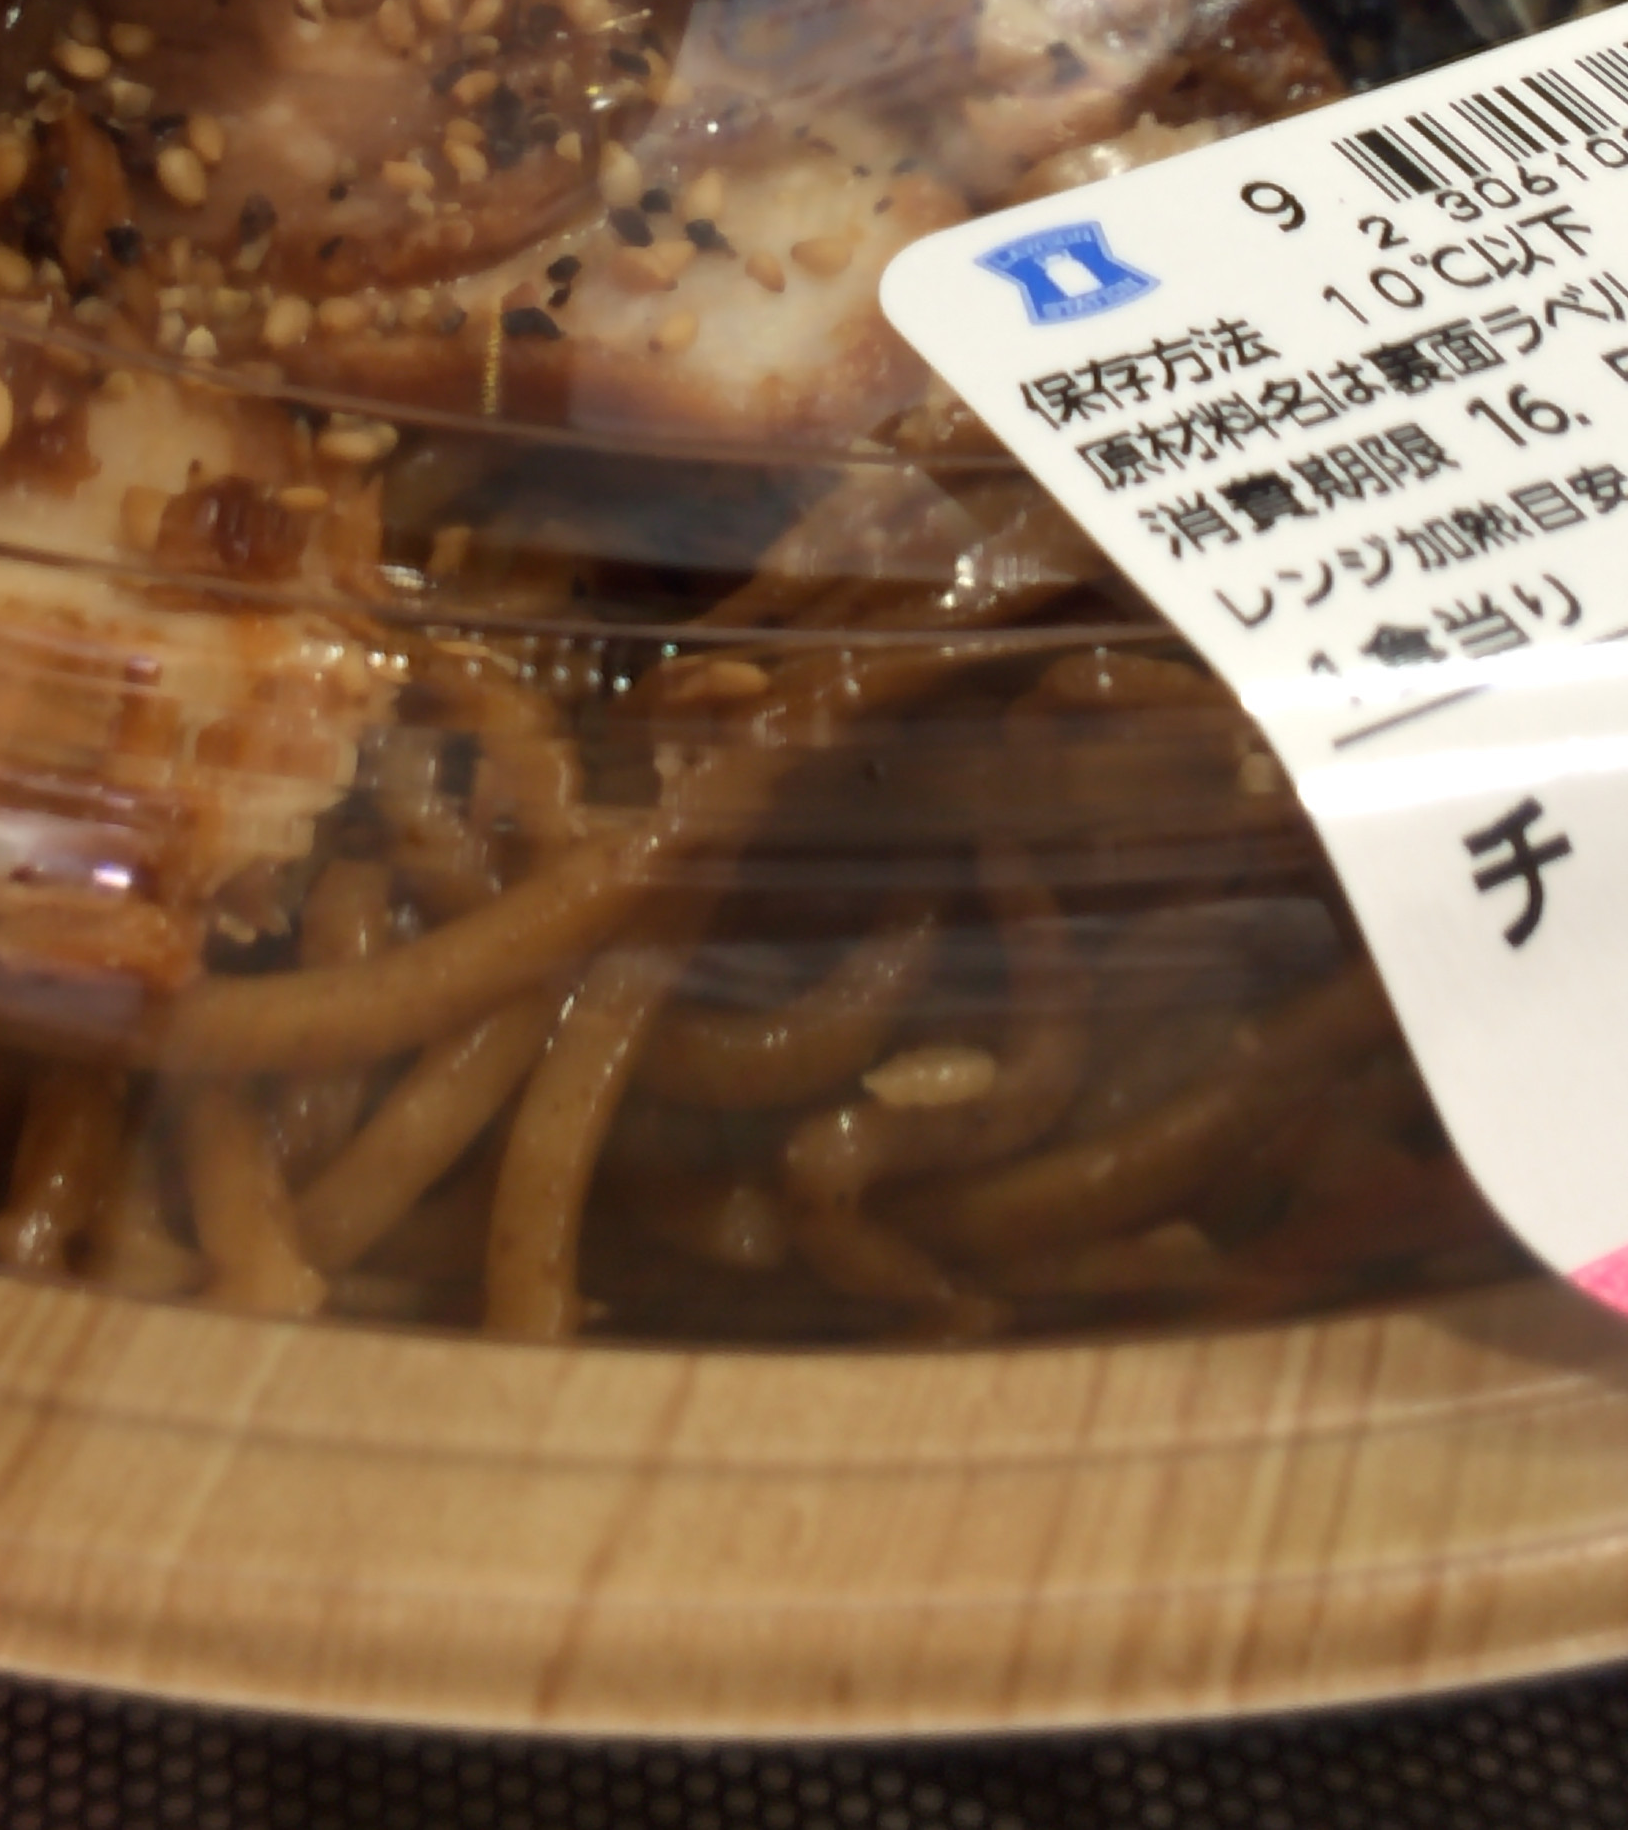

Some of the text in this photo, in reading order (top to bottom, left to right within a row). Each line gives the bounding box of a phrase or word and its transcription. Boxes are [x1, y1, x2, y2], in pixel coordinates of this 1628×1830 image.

[1238, 179, 1308, 234] 9
[1357, 213, 1410, 253] 2
[1017, 317, 1282, 432] 保存方法
[1138, 421, 1462, 562] 消費期限
